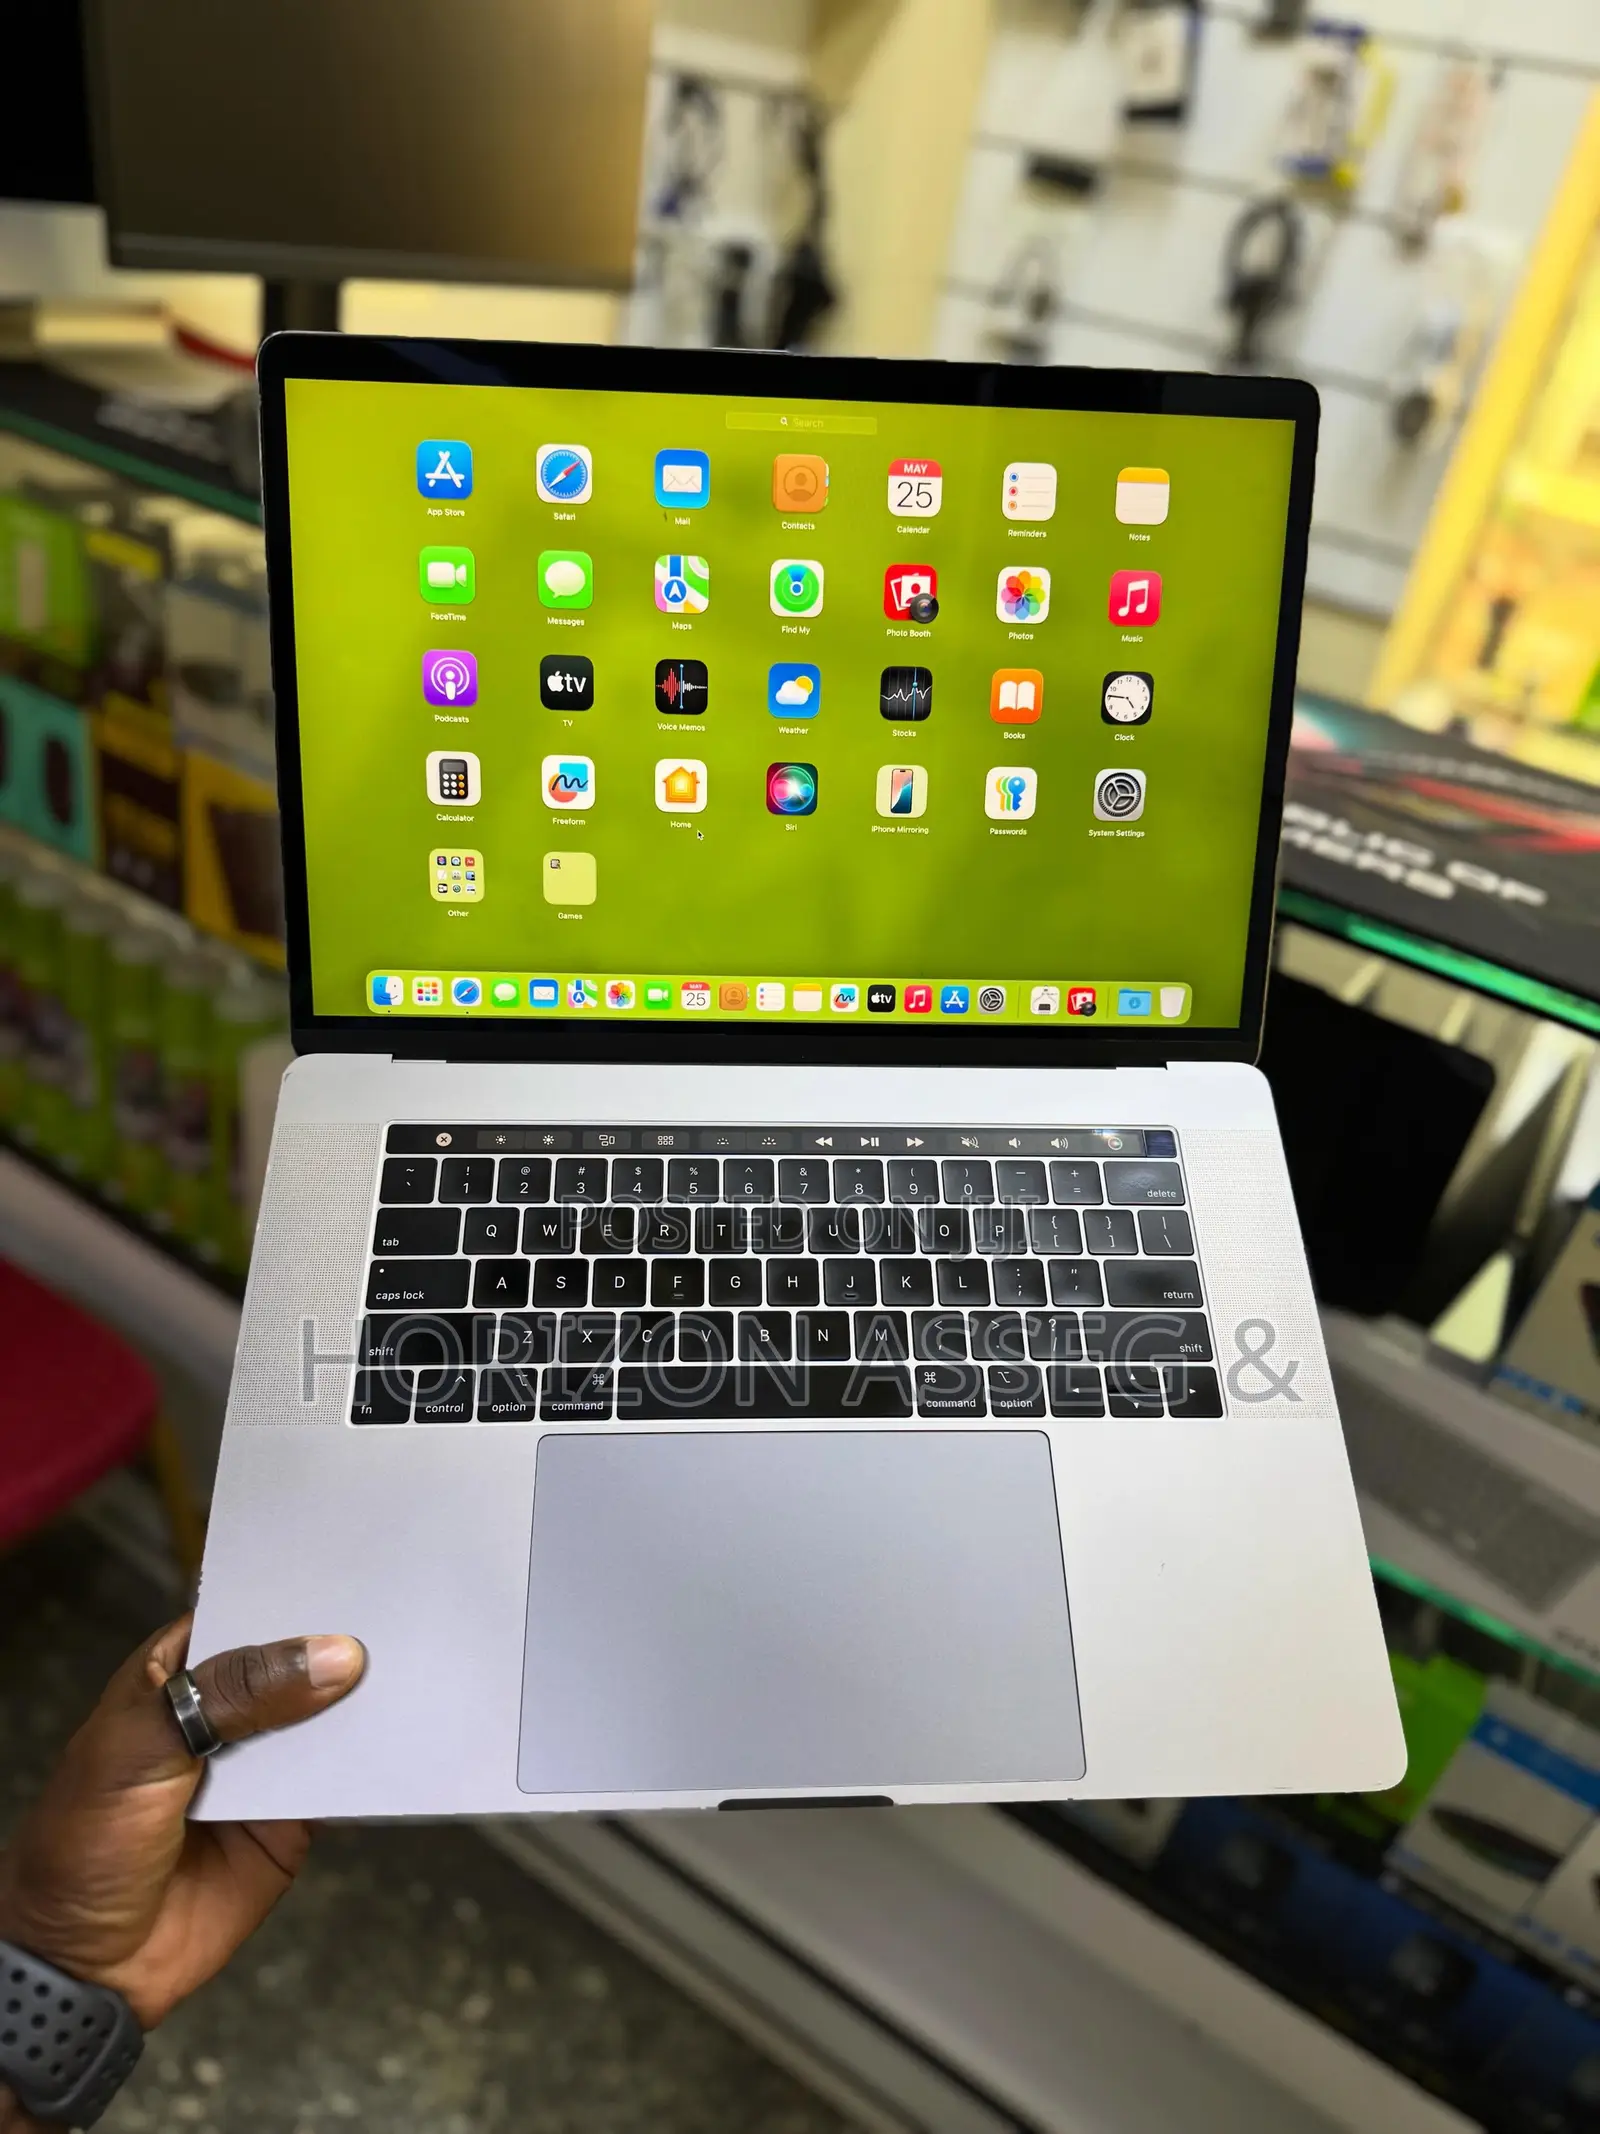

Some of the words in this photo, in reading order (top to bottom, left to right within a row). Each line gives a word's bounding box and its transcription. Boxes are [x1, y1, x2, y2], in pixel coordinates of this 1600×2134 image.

[903, 463, 928, 474] MAY
[897, 481, 932, 508] 25
[426, 507, 443, 517] App
[444, 508, 466, 517] Store
[553, 512, 576, 521] Safari
[674, 517, 691, 526] Mail
[781, 520, 816, 531] Contacts
[896, 525, 931, 534] Calendar
[1007, 528, 1047, 538] Reminders
[1128, 533, 1151, 542] Notes
[430, 612, 467, 622] FaceTime
[546, 616, 585, 627] Messages
[671, 621, 693, 631] Maps
[781, 625, 797, 634] Find
[799, 625, 811, 636] My
[886, 628, 908, 637] Photo
[909, 629, 932, 638] Booth
[1008, 631, 1034, 641] Photos
[1120, 634, 1144, 643] Music
[563, 673, 587, 693] tv
[433, 714, 470, 724] Podcasts
[562, 719, 574, 727] TV
[657, 722, 678, 731] Voice
[678, 723, 706, 732] Memos
[778, 726, 809, 735] Weather
[891, 728, 917, 737] Stocks
[1003, 731, 1026, 740] Books
[1114, 733, 1135, 742] Clock
[435, 813, 475, 822] Calculator
[552, 817, 586, 826] Freeform
[670, 820, 692, 829] Home
[785, 823, 798, 831] Siri
[871, 825, 897, 833] iPhone
[896, 825, 930, 835] Mirroring
[989, 827, 1028, 836] Passwords
[1088, 829, 1114, 838] System
[1115, 829, 1146, 839] Settings
[447, 909, 470, 918] Other
[557, 912, 584, 920] Games
[686, 992, 706, 1006] 25
[880, 993, 893, 1004] tv
[519, 1181, 529, 1194] 2
[576, 1181, 586, 1194] 3
[632, 1182, 643, 1194] 4
[689, 1182, 698, 1195] 5
[744, 1182, 754, 1195] 6
[800, 1182, 809, 1195] 7
[854, 1183, 864, 1196] 8
[909, 1182, 919, 1195] 9
[963, 1183, 973, 1196] 0
[1146, 1189, 1177, 1198] delete
[485, 1224, 497, 1238] Q
[542, 1224, 558, 1237] W
[603, 1223, 612, 1237] E
[659, 1223, 670, 1237] R
[716, 1224, 727, 1237] T
[772, 1224, 783, 1237] Y
[828, 1224, 839, 1237] U
[939, 1224, 950, 1237] O
[995, 1225, 1005, 1237] P
[382, 1237, 400, 1247] tab
[495, 1276, 508, 1289] A
[555, 1275, 567, 1289] S
[614, 1275, 626, 1289] D
[673, 1275, 682, 1289] F
[730, 1275, 741, 1289] G
[787, 1275, 798, 1288] H
[846, 1275, 854, 1289] J
[901, 1275, 912, 1289] K
[958, 1275, 968, 1289] L
[375, 1292, 401, 1302] caps
[402, 1290, 425, 1300] lock
[1163, 1291, 1195, 1299] return
[522, 1330, 533, 1344] Z
[581, 1329, 593, 1343] X
[641, 1329, 653, 1343] C
[700, 1329, 712, 1343] V
[759, 1328, 770, 1342] B
[817, 1328, 829, 1342] N
[875, 1328, 888, 1342] M
[368, 1346, 394, 1356] shift
[1179, 1343, 1204, 1353] shift
[360, 1403, 374, 1415] fn
[424, 1401, 464, 1413] control
[491, 1401, 527, 1414] option
[551, 1400, 604, 1411] command
[925, 1398, 976, 1408] command
[999, 1399, 1033, 1409] option
